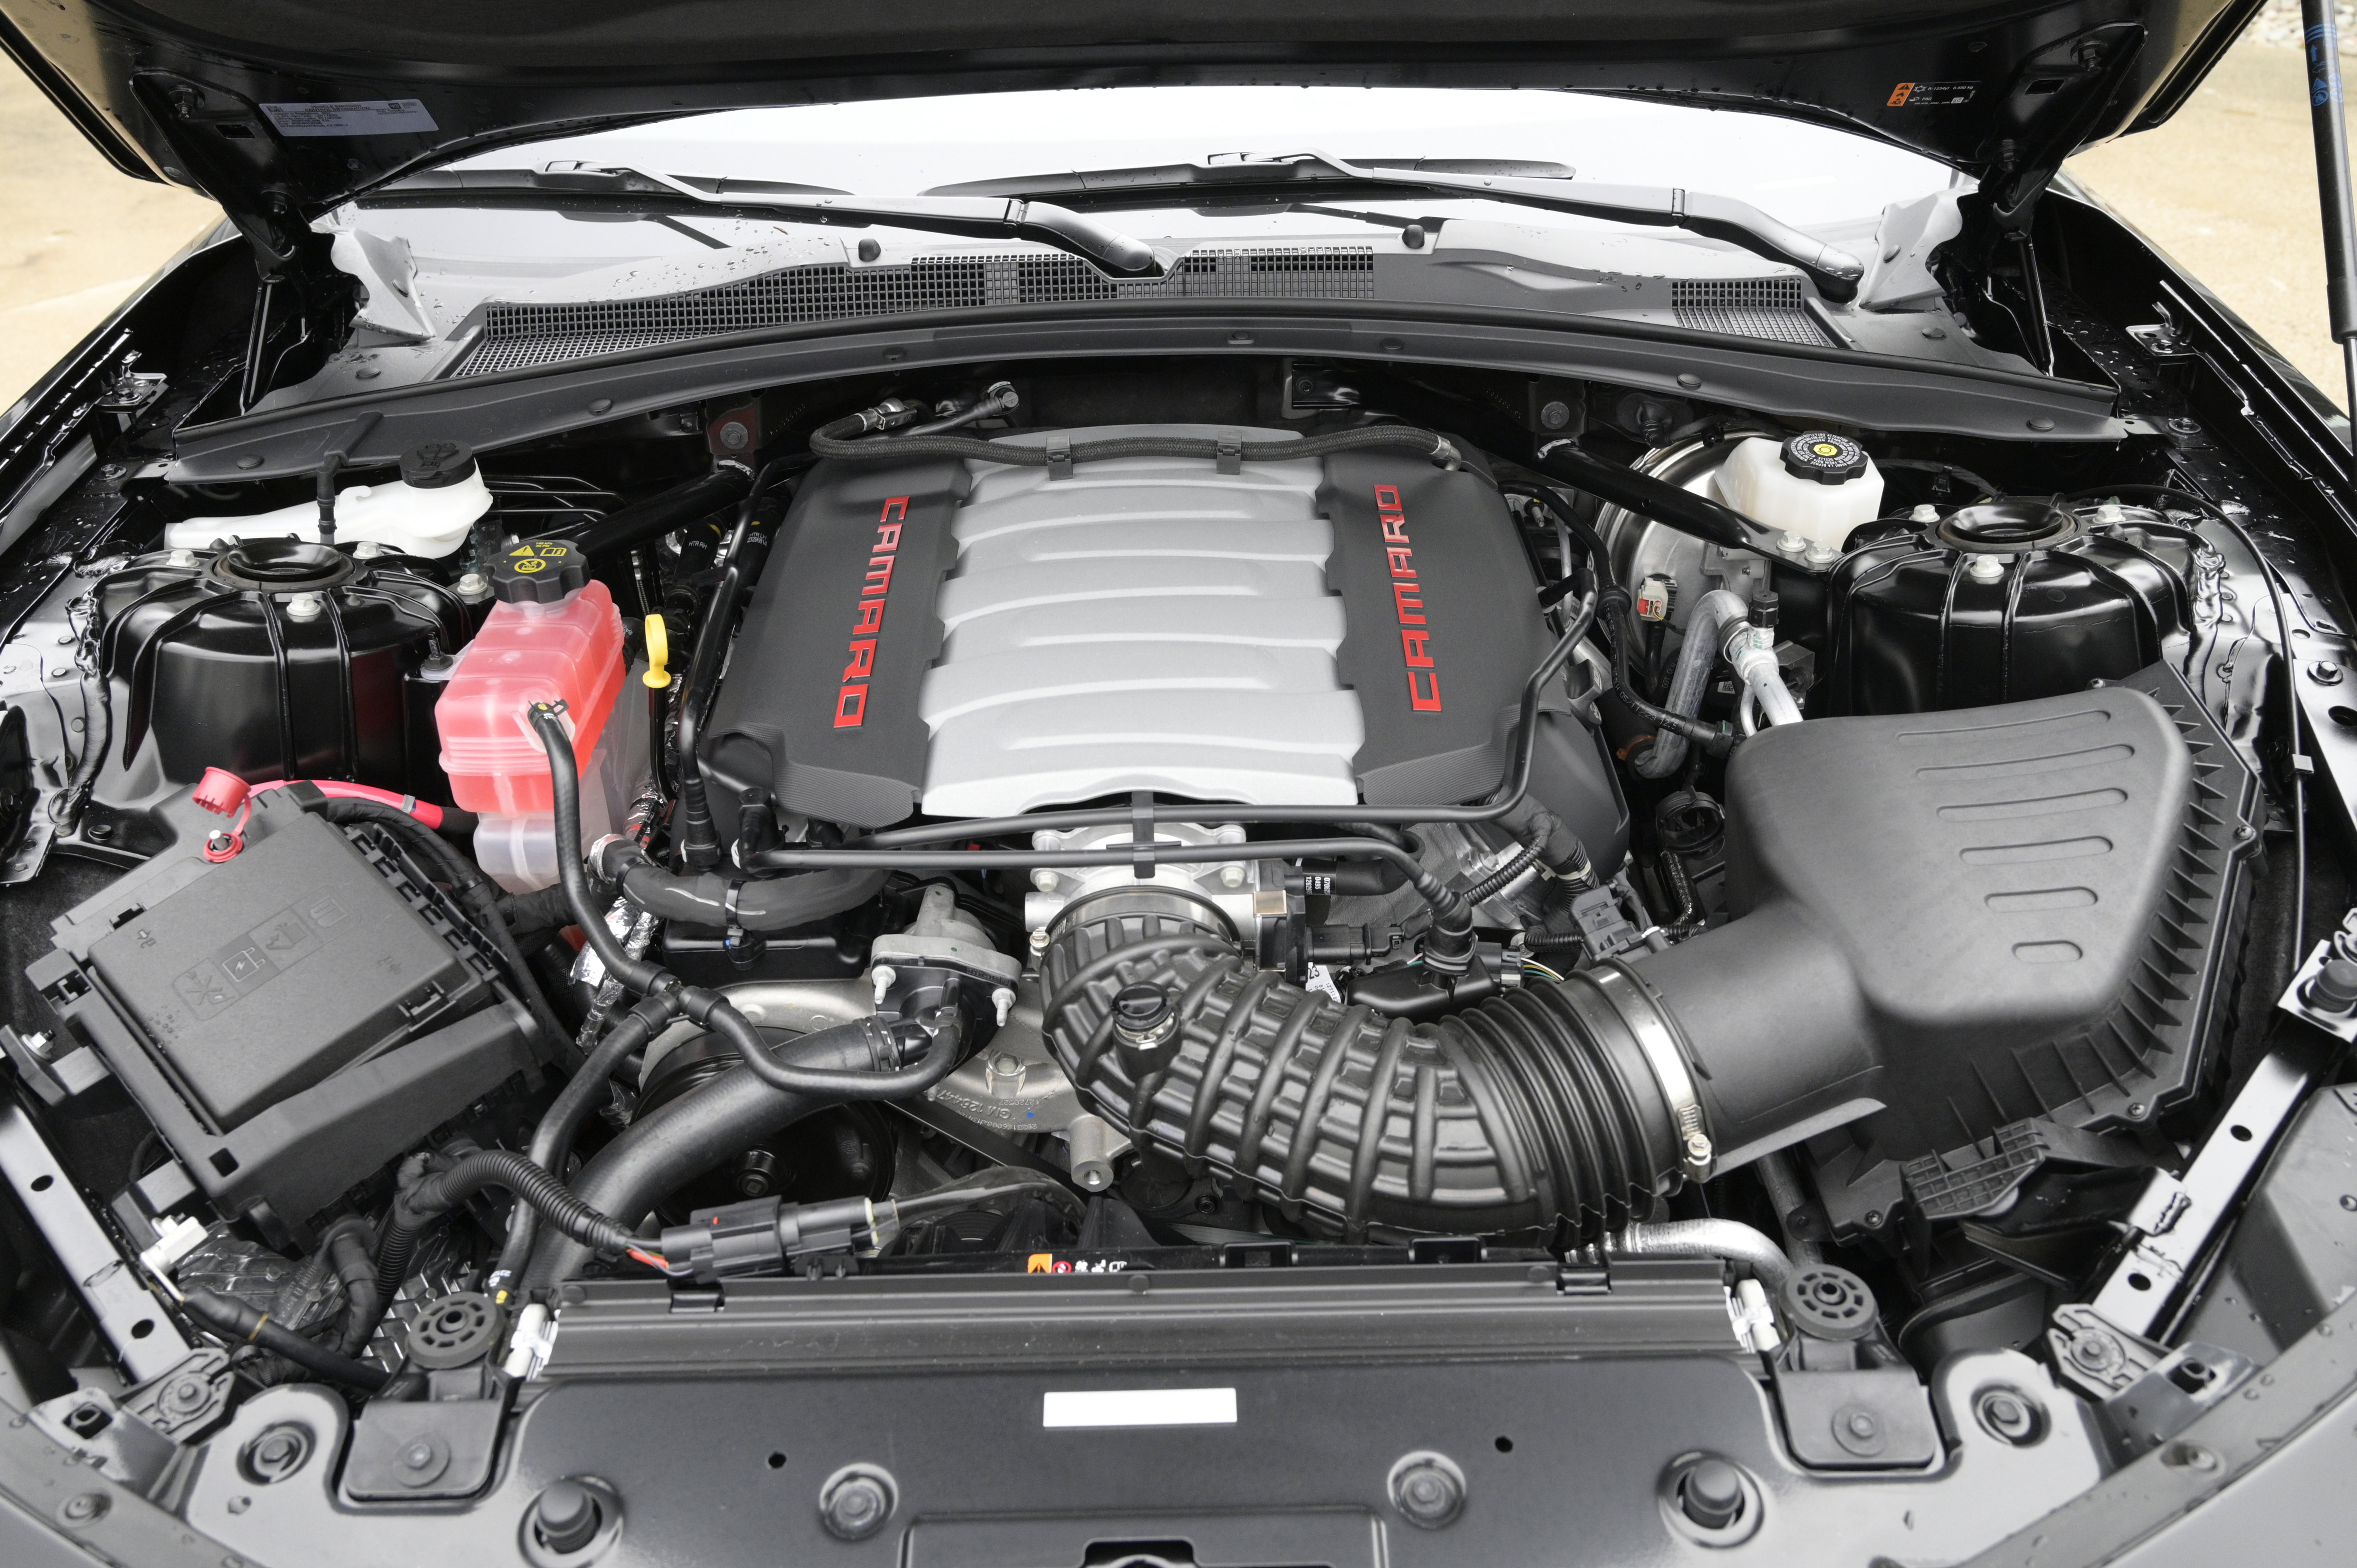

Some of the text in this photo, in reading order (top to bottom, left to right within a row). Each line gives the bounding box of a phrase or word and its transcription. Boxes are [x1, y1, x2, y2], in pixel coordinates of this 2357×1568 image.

[834, 496, 910, 728] CAMARO
[1374, 484, 1442, 711] CAMARO
[987, 1105, 1012, 1119] GM
